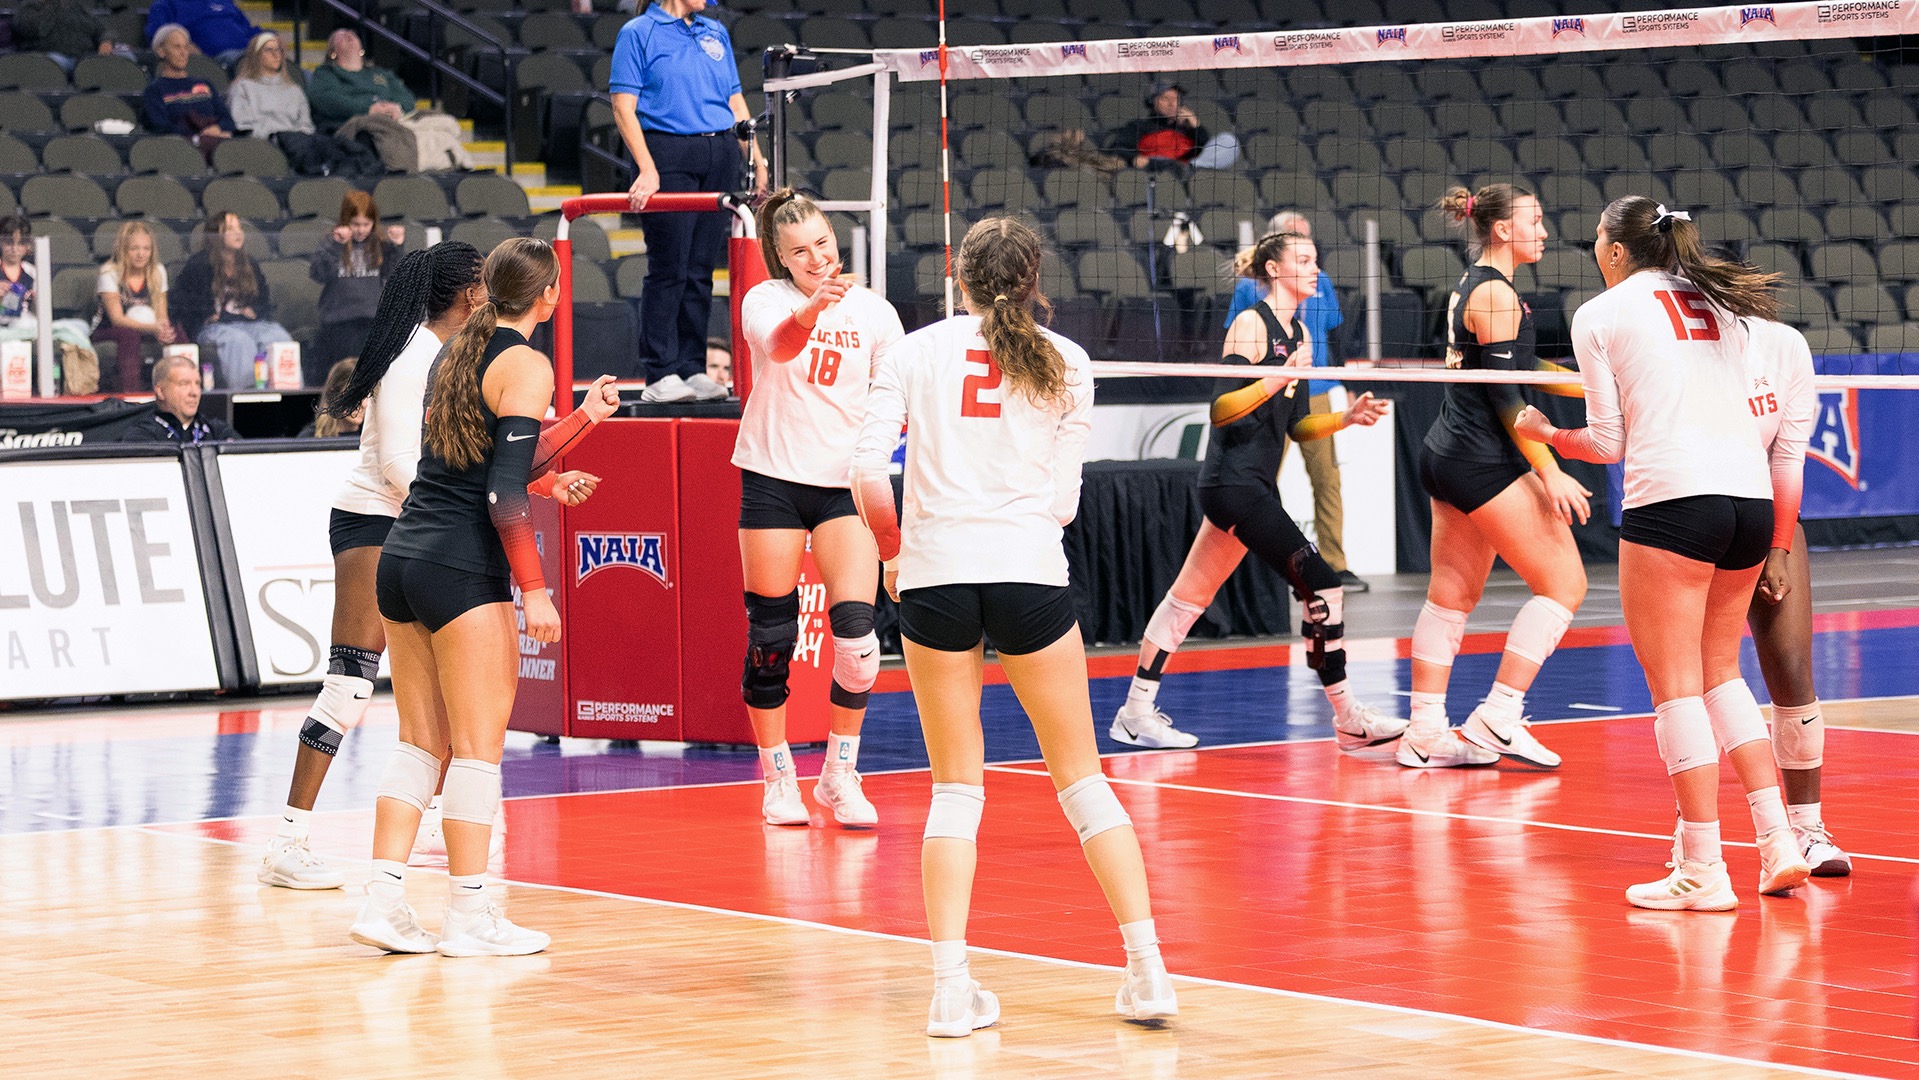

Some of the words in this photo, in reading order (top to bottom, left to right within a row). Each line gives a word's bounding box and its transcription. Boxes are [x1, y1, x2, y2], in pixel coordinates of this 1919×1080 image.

[1832, 0, 1900, 13] PERFORMANCE
[1637, 11, 1698, 24] PERFORMANCE
[1740, 7, 1775, 24] NAIA
[1832, 12, 1859, 21] SPORTS
[1860, 11, 1889, 20] SYSTEMS
[1455, 22, 1515, 33] PERFORMANCE
[1553, 18, 1584, 33] NAIA
[1638, 24, 1661, 32] SPORTS
[1662, 22, 1689, 31] SYSTEMS
[1287, 32, 1341, 43] PERFORMANCE
[1377, 28, 1406, 43] NAIA
[1456, 33, 1478, 41] SPORTS
[1479, 32, 1505, 40] SYSTEMS
[1130, 40, 1180, 49] PERFORMANCE
[1214, 36, 1241, 51] NAIA
[919, 51, 940, 65] NAI
[1061, 44, 1086, 58] NAIA
[1653, 290, 1720, 341] 15
[807, 347, 842, 387] 18
[961, 349, 1003, 418] 2
[579, 535, 665, 579] NAIA
[595, 702, 674, 716] PERFORMANCE
[595, 713, 624, 722] SPORTS
[625, 714, 658, 723] SYSTEMS
